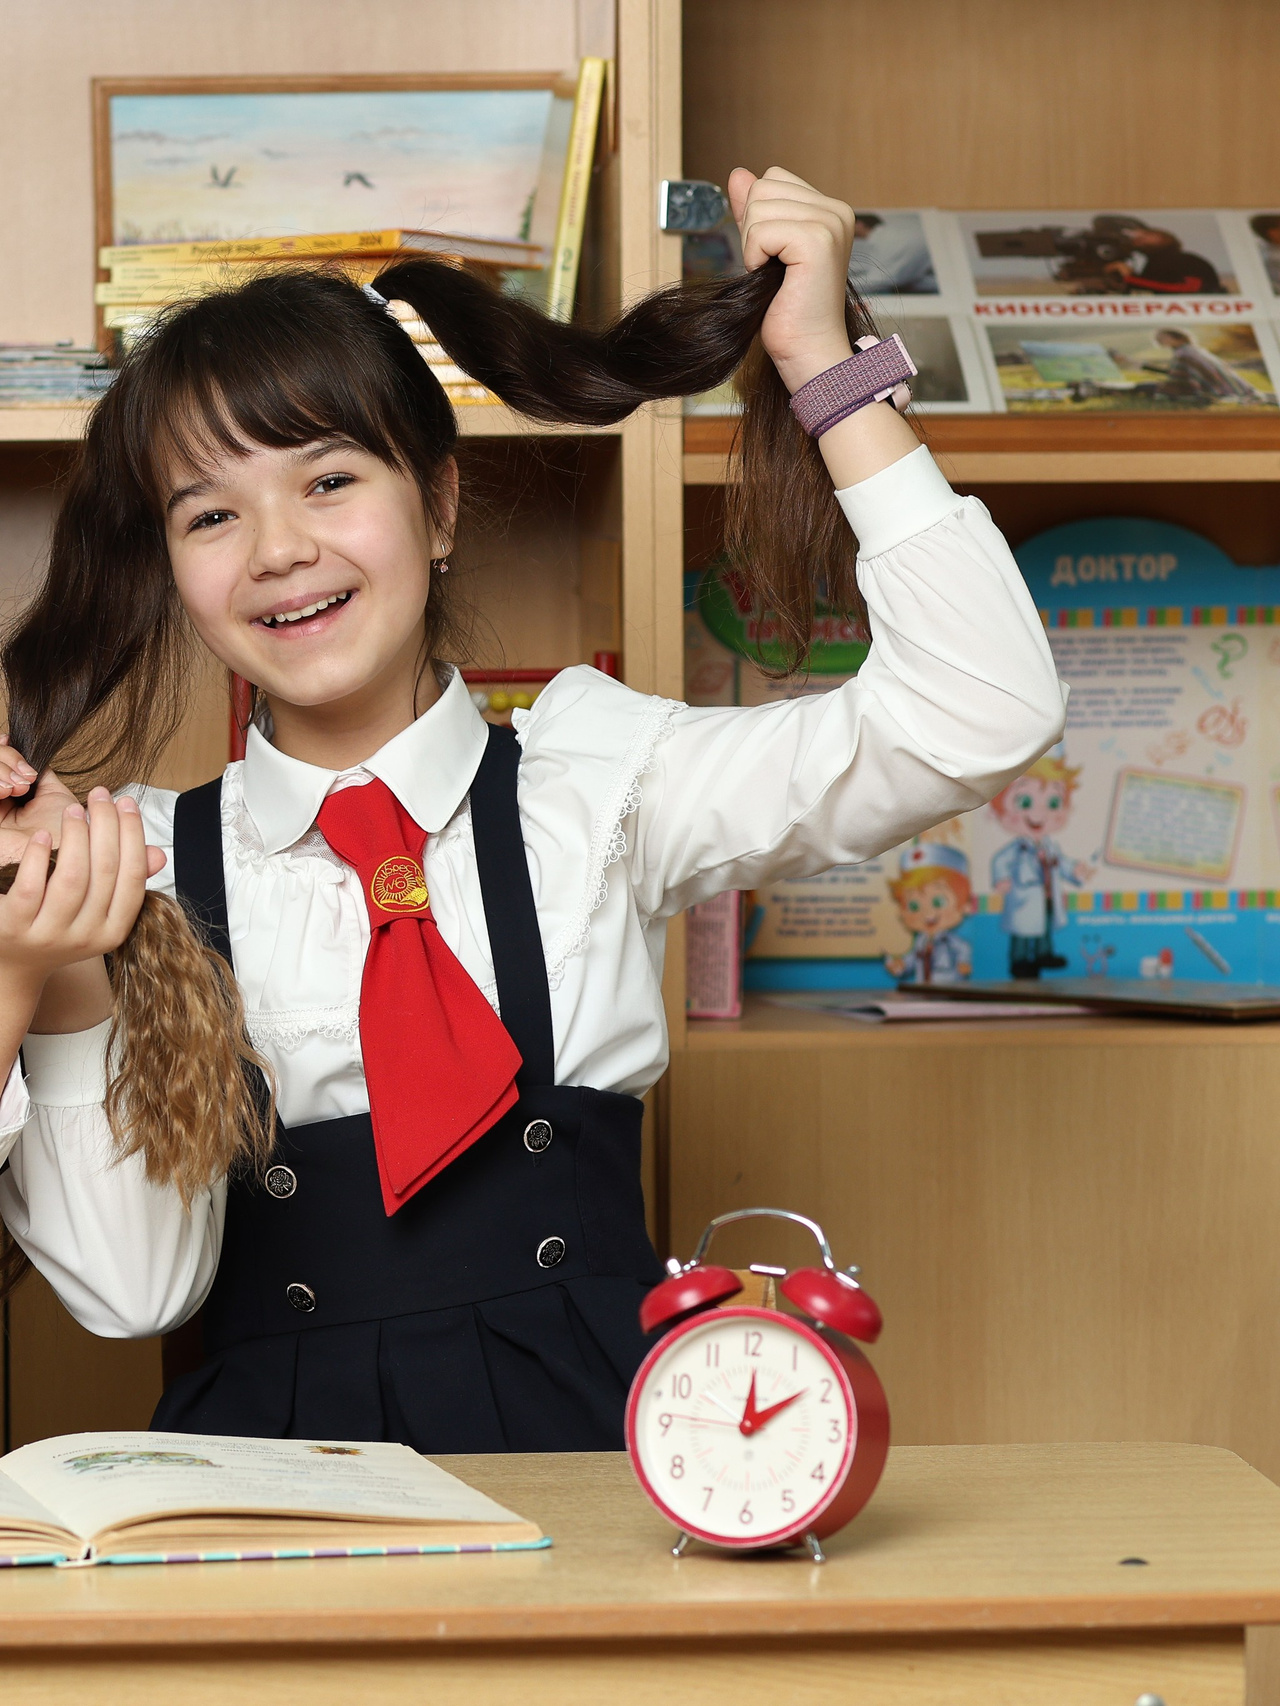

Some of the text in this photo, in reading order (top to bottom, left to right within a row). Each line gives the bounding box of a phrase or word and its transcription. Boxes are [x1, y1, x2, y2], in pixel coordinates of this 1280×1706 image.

[973, 301, 1253, 317] КИНООПЕРАТОР
[1050, 552, 1178, 588] ДОКТОР
[706, 1343, 720, 1368] 11
[744, 1331, 763, 1357] 12
[793, 1344, 798, 1372] 1
[671, 1373, 692, 1399] 10
[819, 1378, 833, 1404] 2
[658, 1412, 673, 1437] 9
[828, 1418, 842, 1444] 3
[670, 1454, 684, 1480] 8
[810, 1461, 826, 1483] 4
[701, 1487, 714, 1512] 7
[738, 1499, 754, 1525] 6
[781, 1489, 795, 1513] 5
